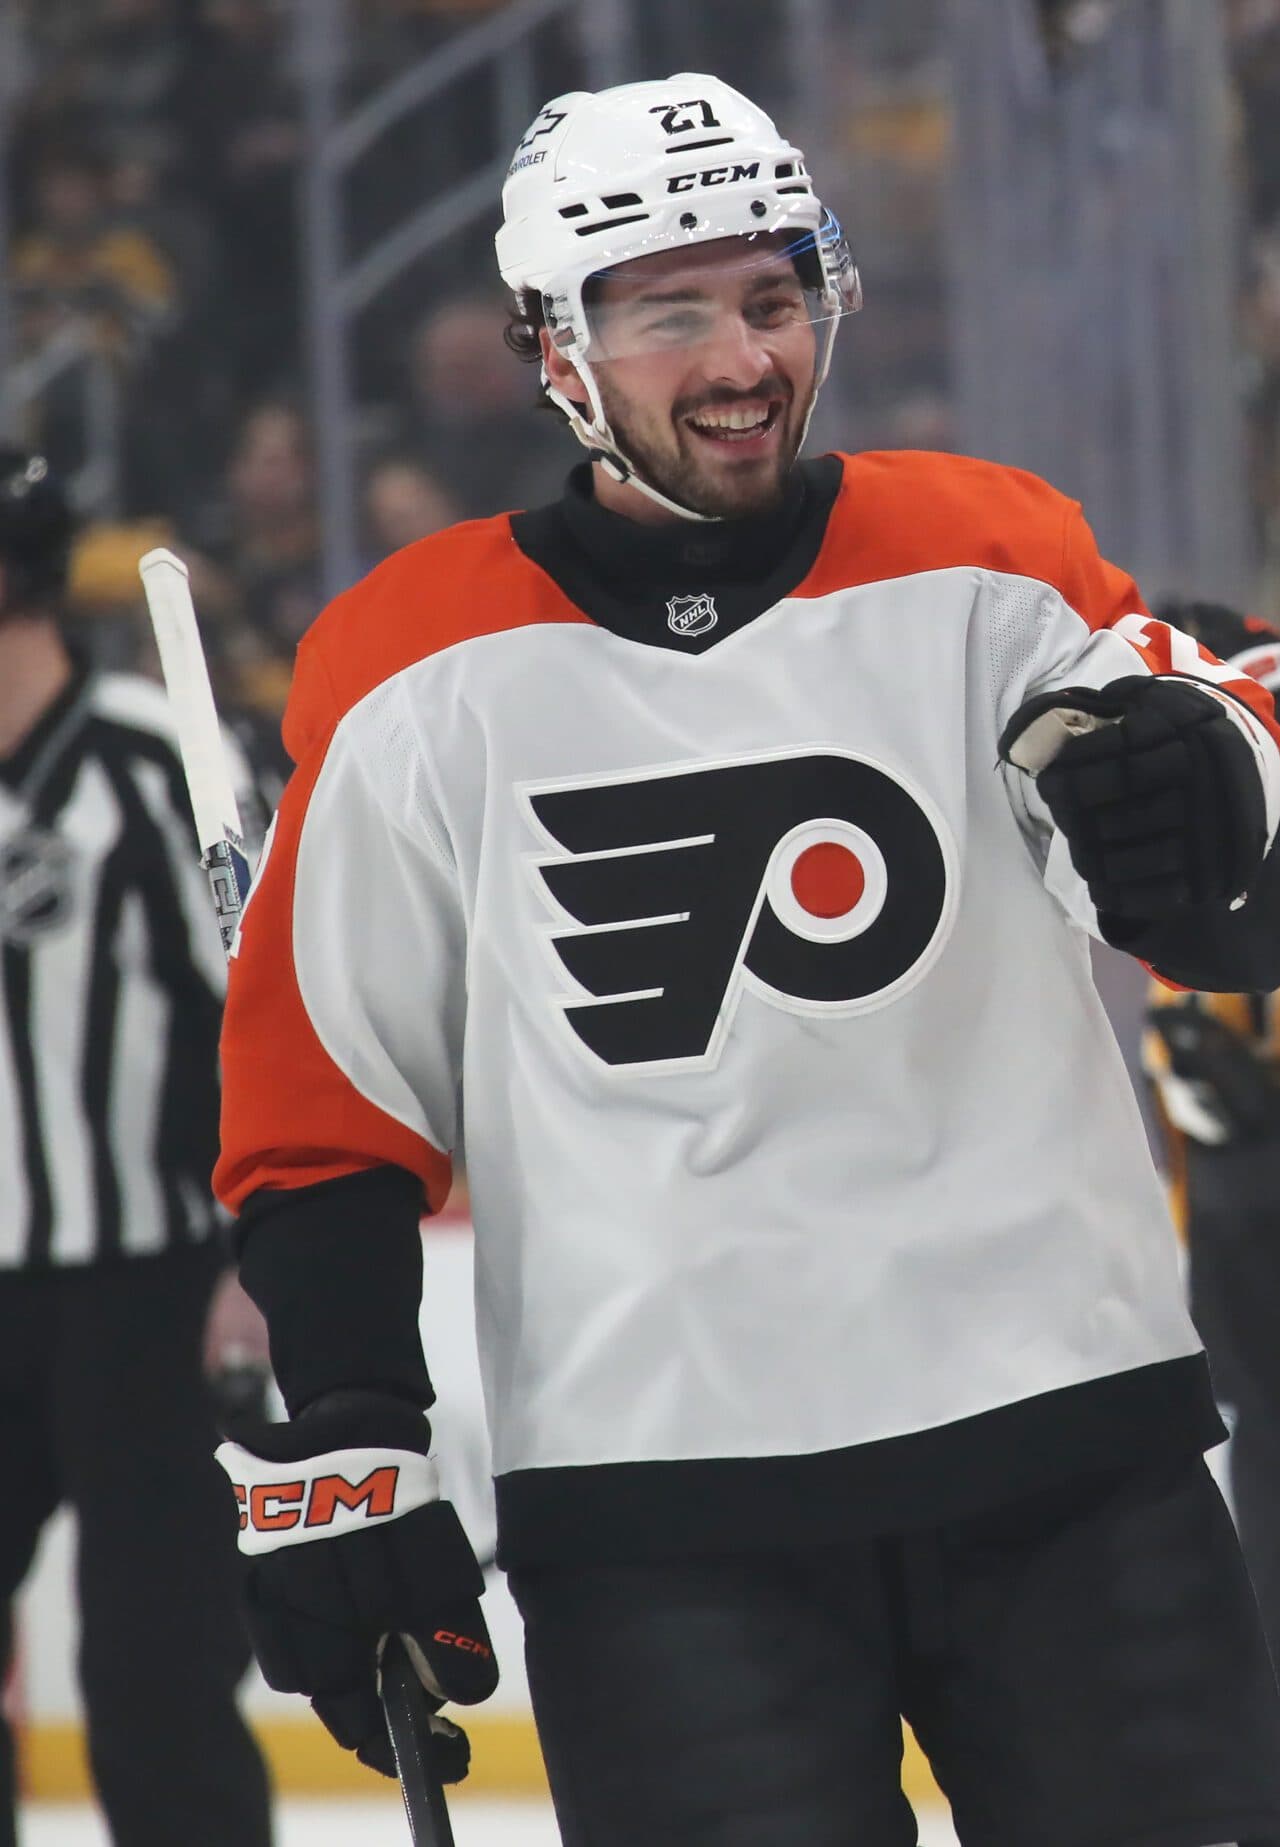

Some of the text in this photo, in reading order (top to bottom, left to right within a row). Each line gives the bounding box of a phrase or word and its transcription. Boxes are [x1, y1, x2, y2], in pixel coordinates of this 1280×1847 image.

[666, 161, 761, 194] CCM
[678, 603, 708, 630] NHL
[433, 1629, 491, 1661] CCM
